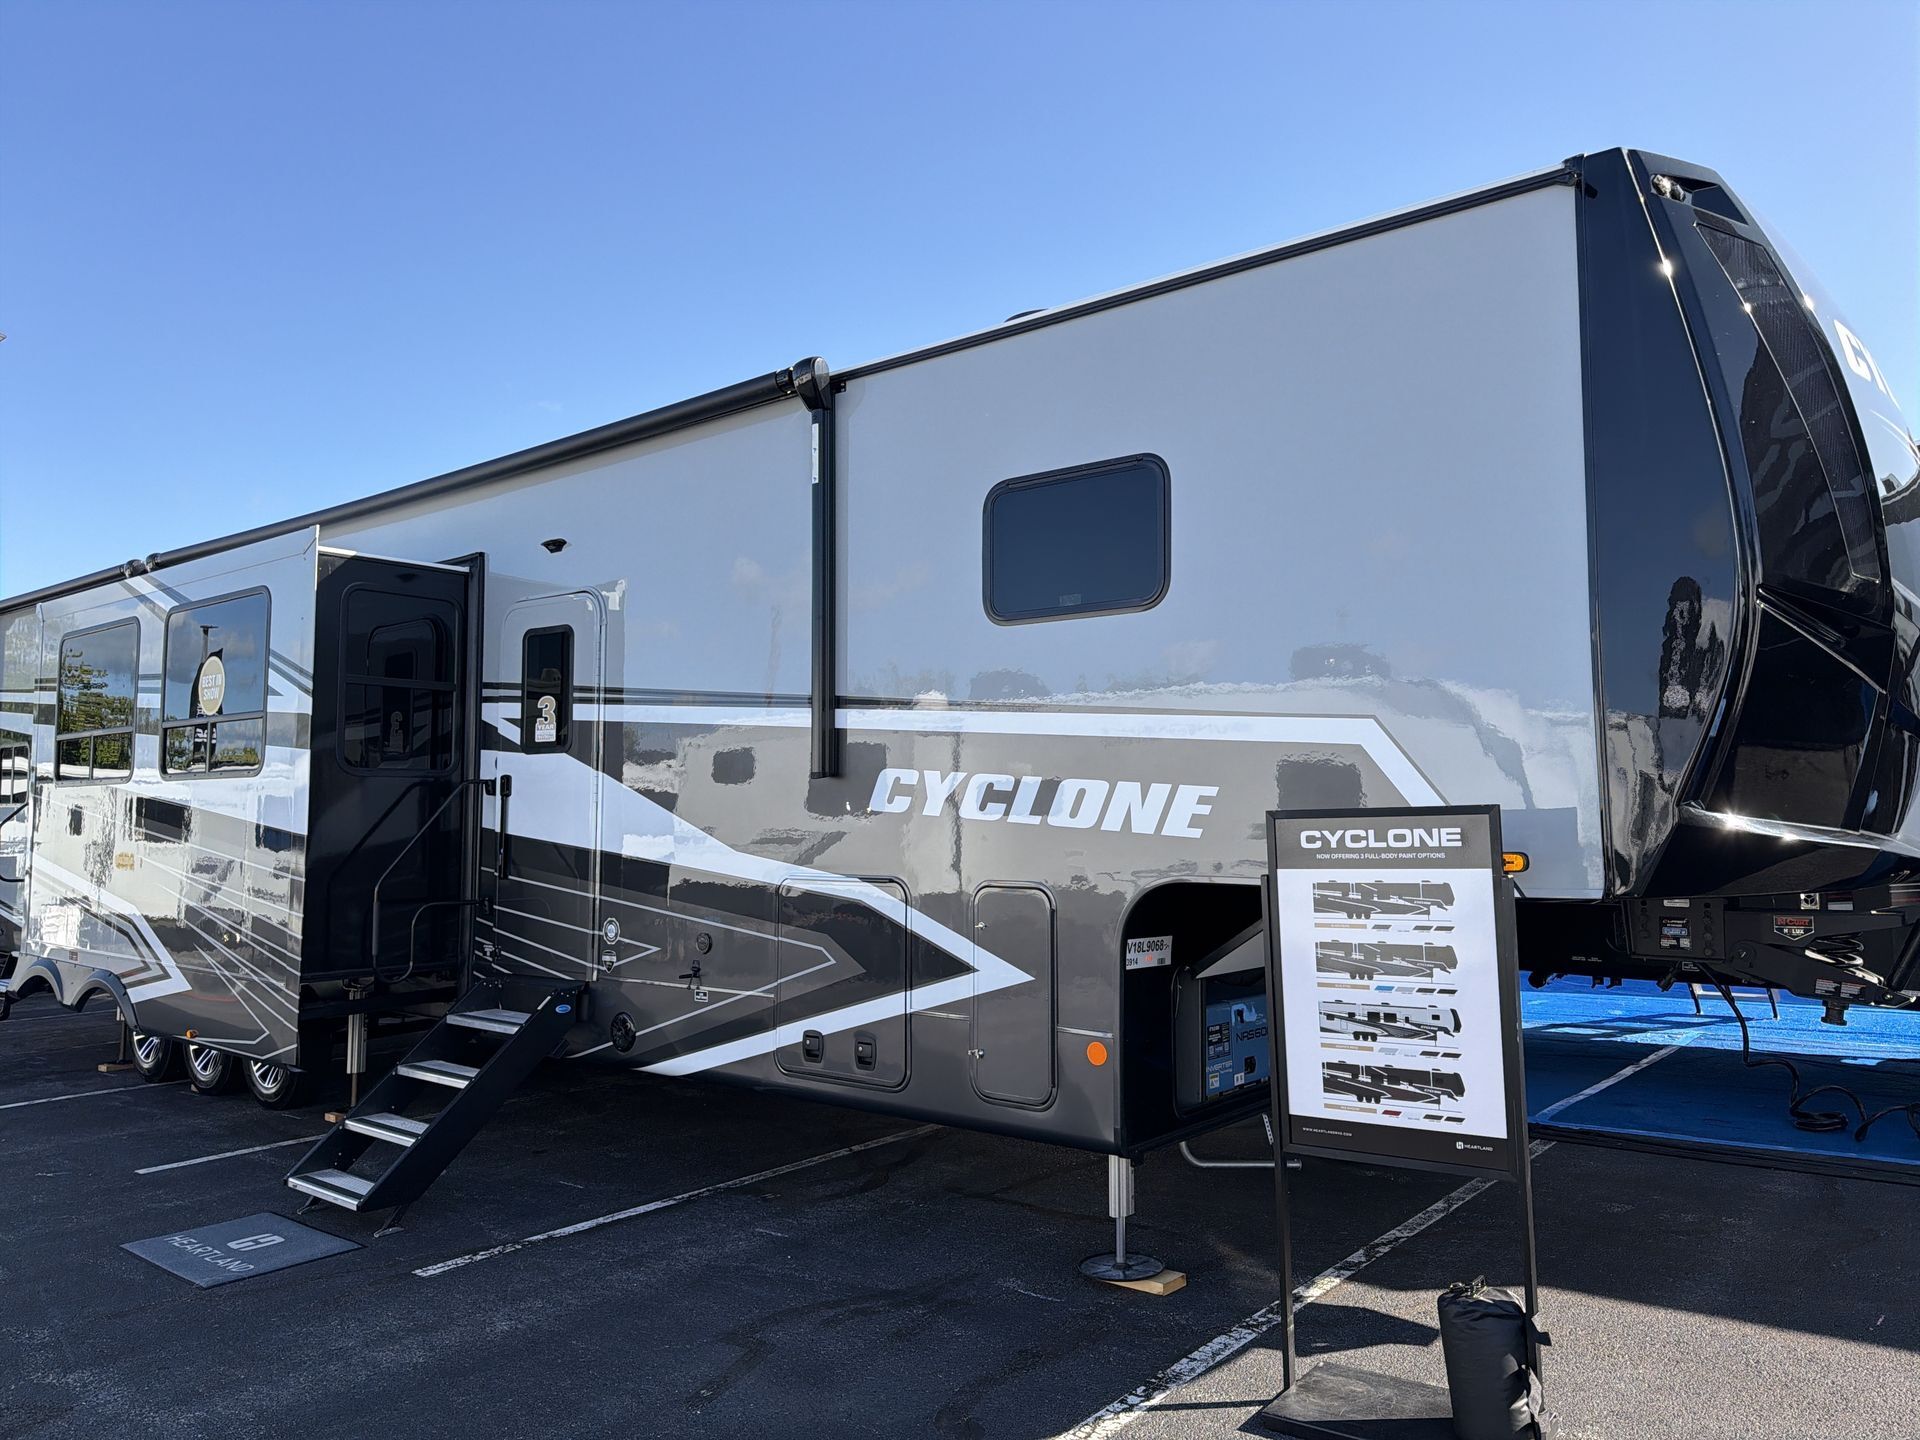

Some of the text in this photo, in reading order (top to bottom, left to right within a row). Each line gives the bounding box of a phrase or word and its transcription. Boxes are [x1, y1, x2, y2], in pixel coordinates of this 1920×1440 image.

[202, 673, 222, 687] BEST IN
[203, 688, 219, 700] SHOW
[537, 695, 556, 725] 3
[869, 768, 1220, 839] CYCLONE
[1300, 828, 1463, 849] CYCLONE
[1464, 1144, 1494, 1152] HEARTLAND
[164, 1235, 255, 1272] HEARTLAND
